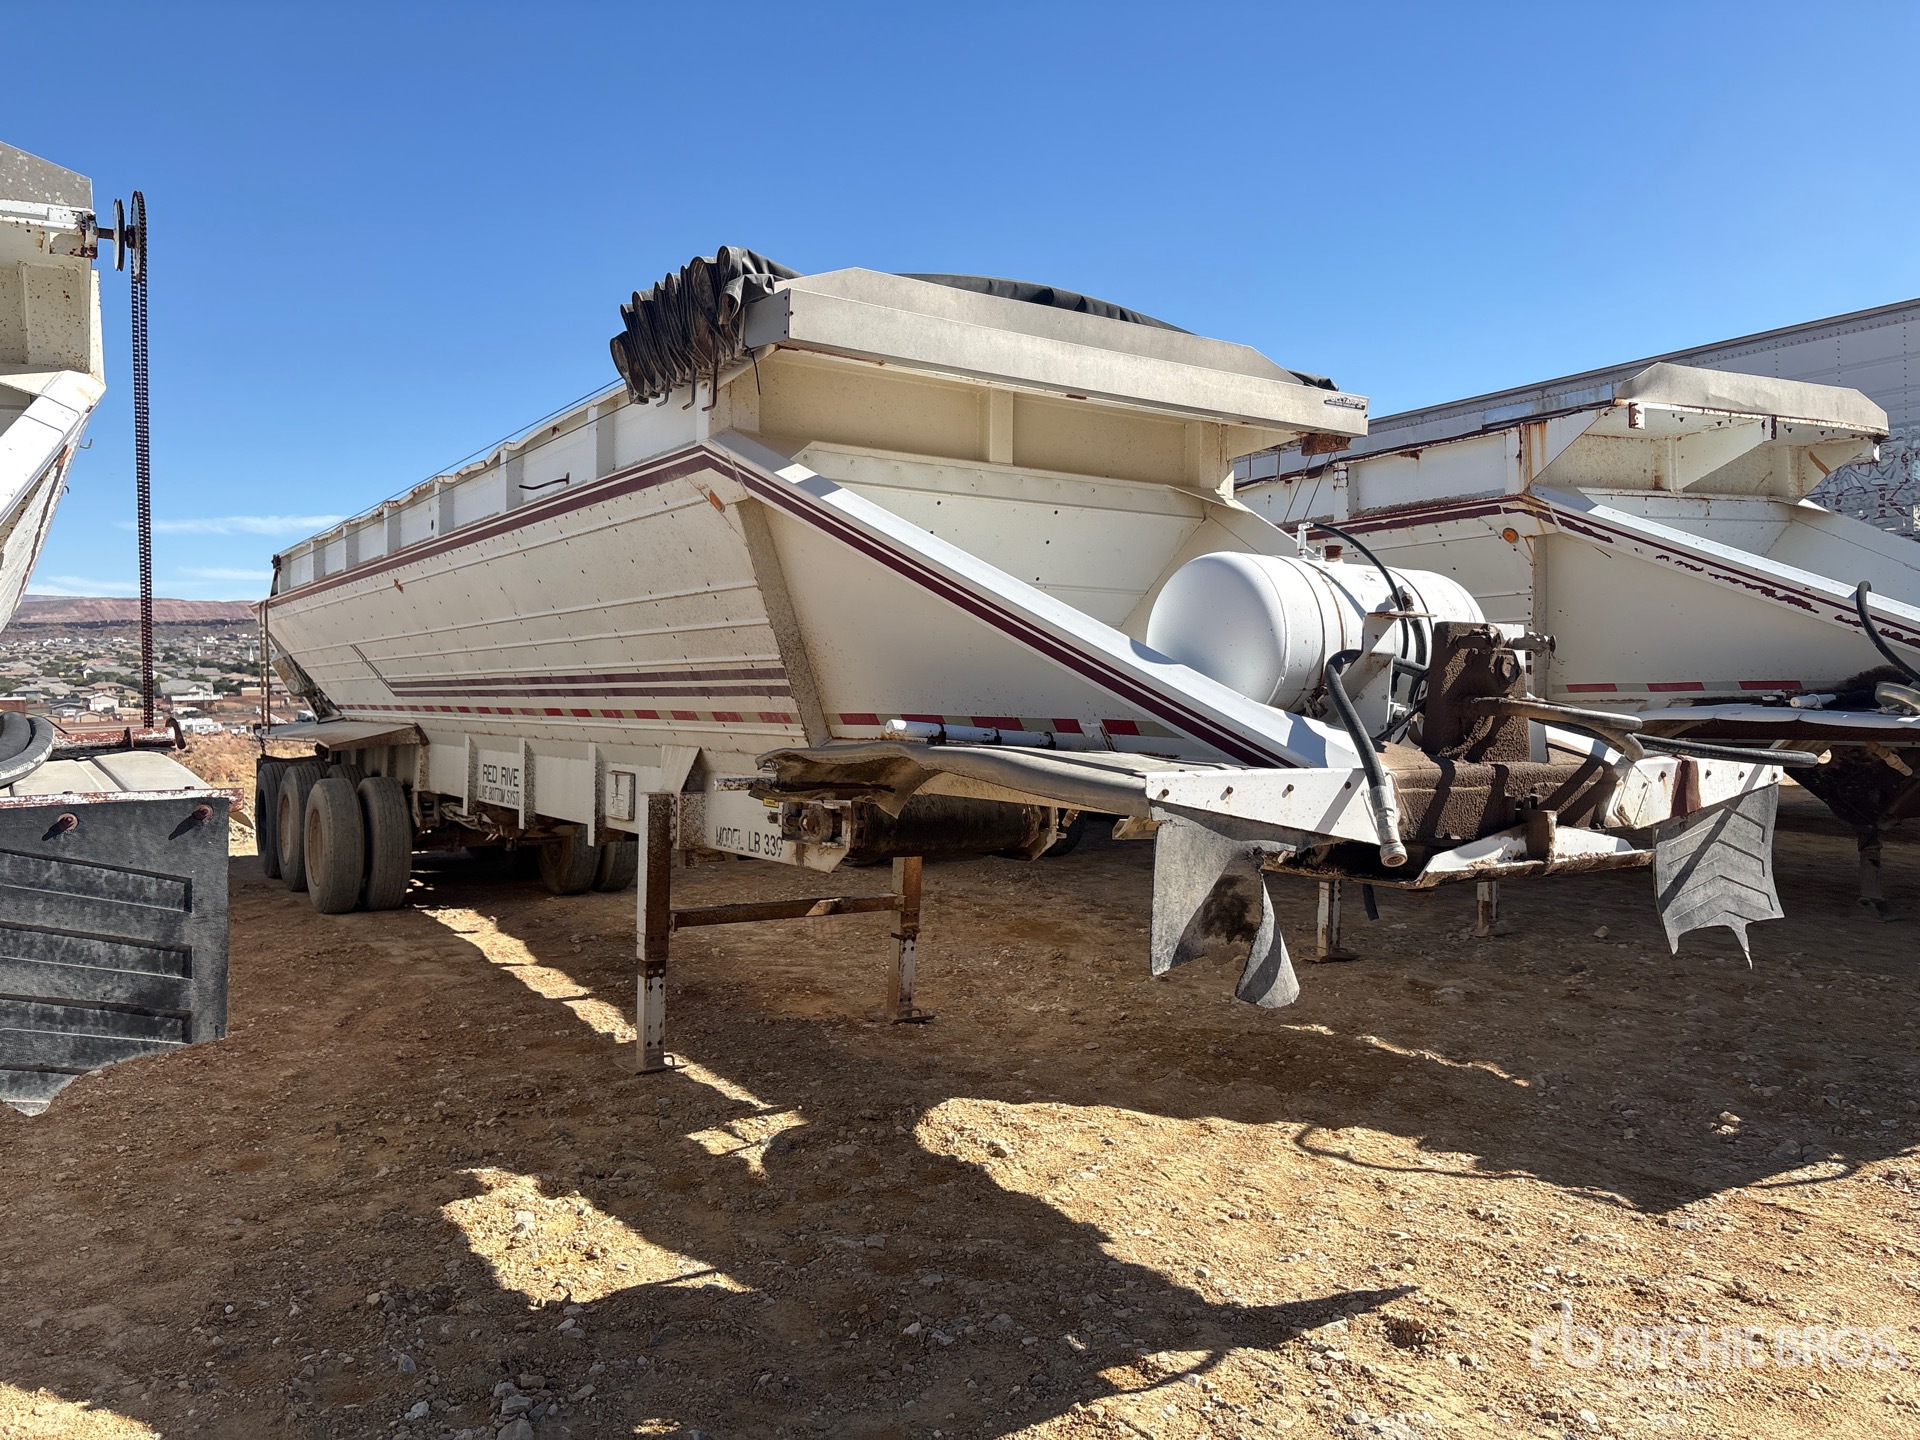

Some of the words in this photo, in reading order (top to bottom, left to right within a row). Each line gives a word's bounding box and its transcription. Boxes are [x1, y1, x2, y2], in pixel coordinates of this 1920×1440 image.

[483, 763, 498, 784] RED
[501, 766, 520, 788] RIVE
[715, 826, 745, 851] MODEL
[748, 831, 761, 853] LB
[764, 834, 784, 858] 339
